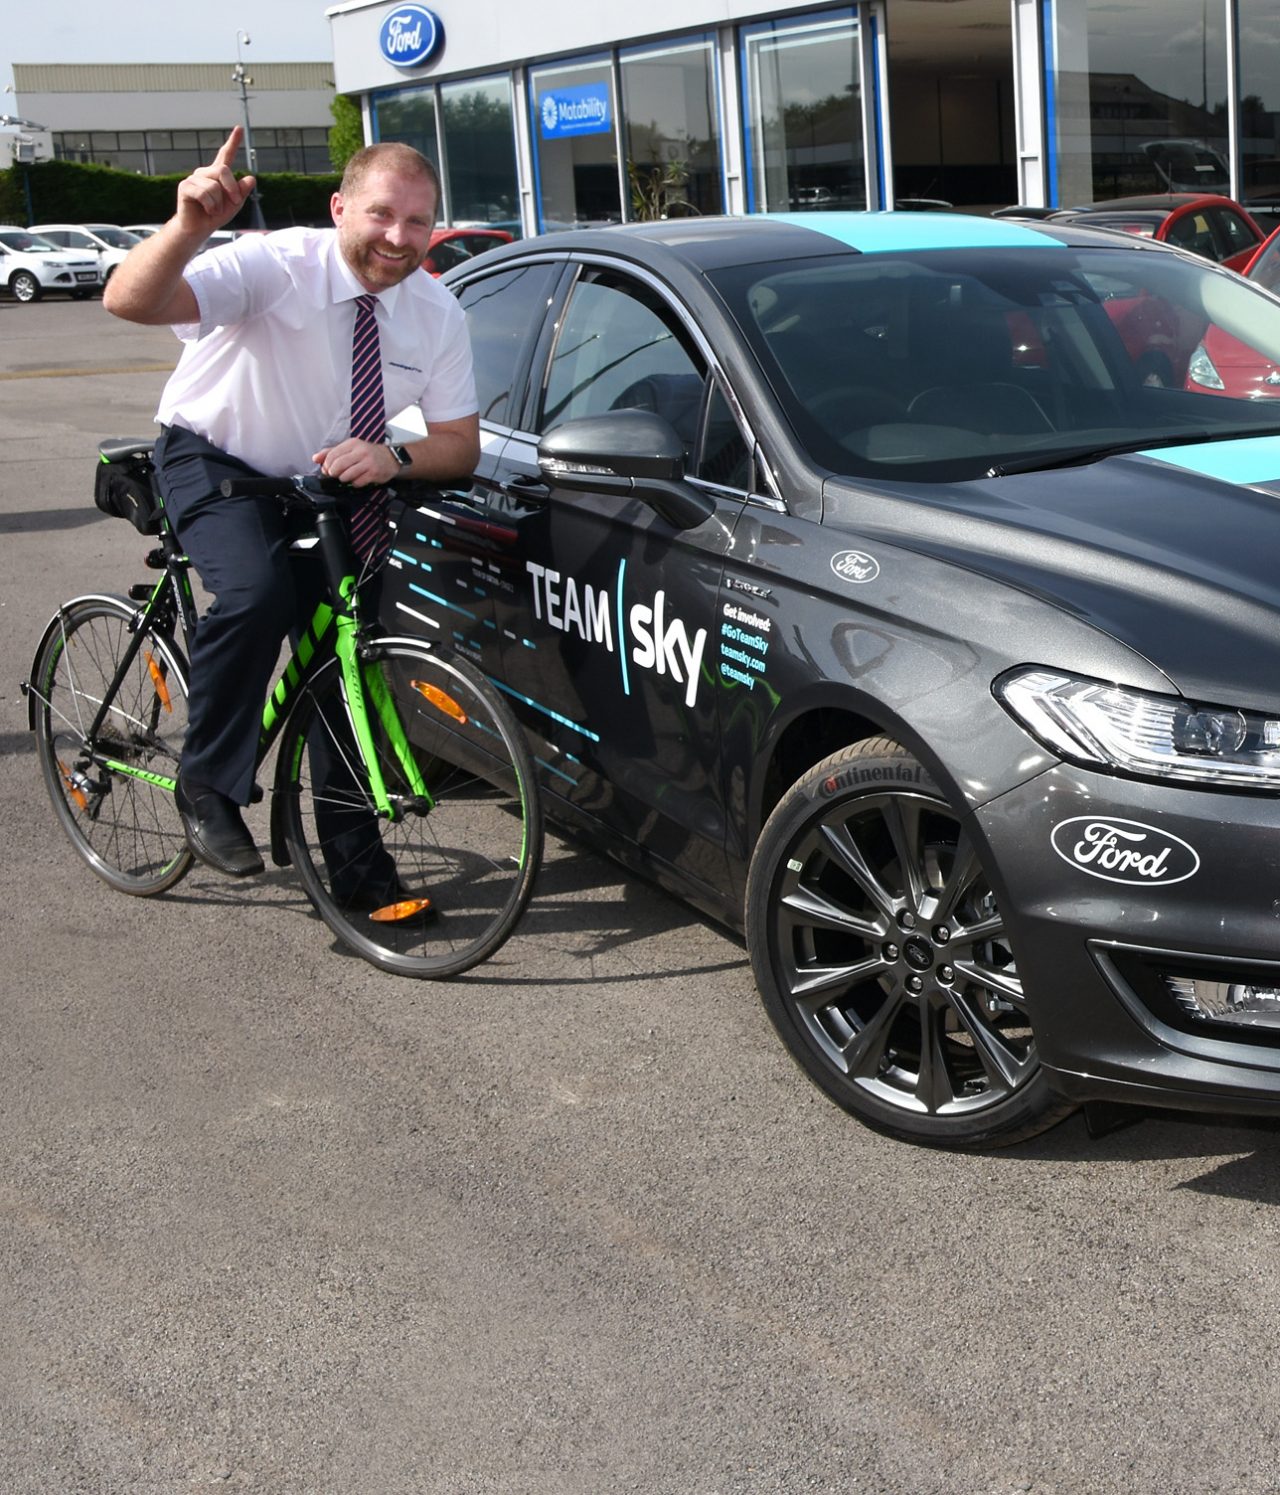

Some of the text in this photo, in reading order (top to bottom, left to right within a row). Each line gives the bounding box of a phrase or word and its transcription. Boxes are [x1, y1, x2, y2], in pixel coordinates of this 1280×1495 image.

[387, 16, 423, 53] Ford
[558, 97, 607, 122] Motability
[836, 553, 872, 580] Ford
[723, 603, 772, 632] Get involved:
[526, 561, 707, 708] TEAM sky
[721, 623, 769, 655] #GoTeamSky
[720, 643, 766, 673] teamsky.com
[720, 663, 755, 691] @teamsky
[126, 766, 173, 785] SCOTT
[818, 764, 921, 799] Continental
[1073, 822, 1172, 878] Ford
